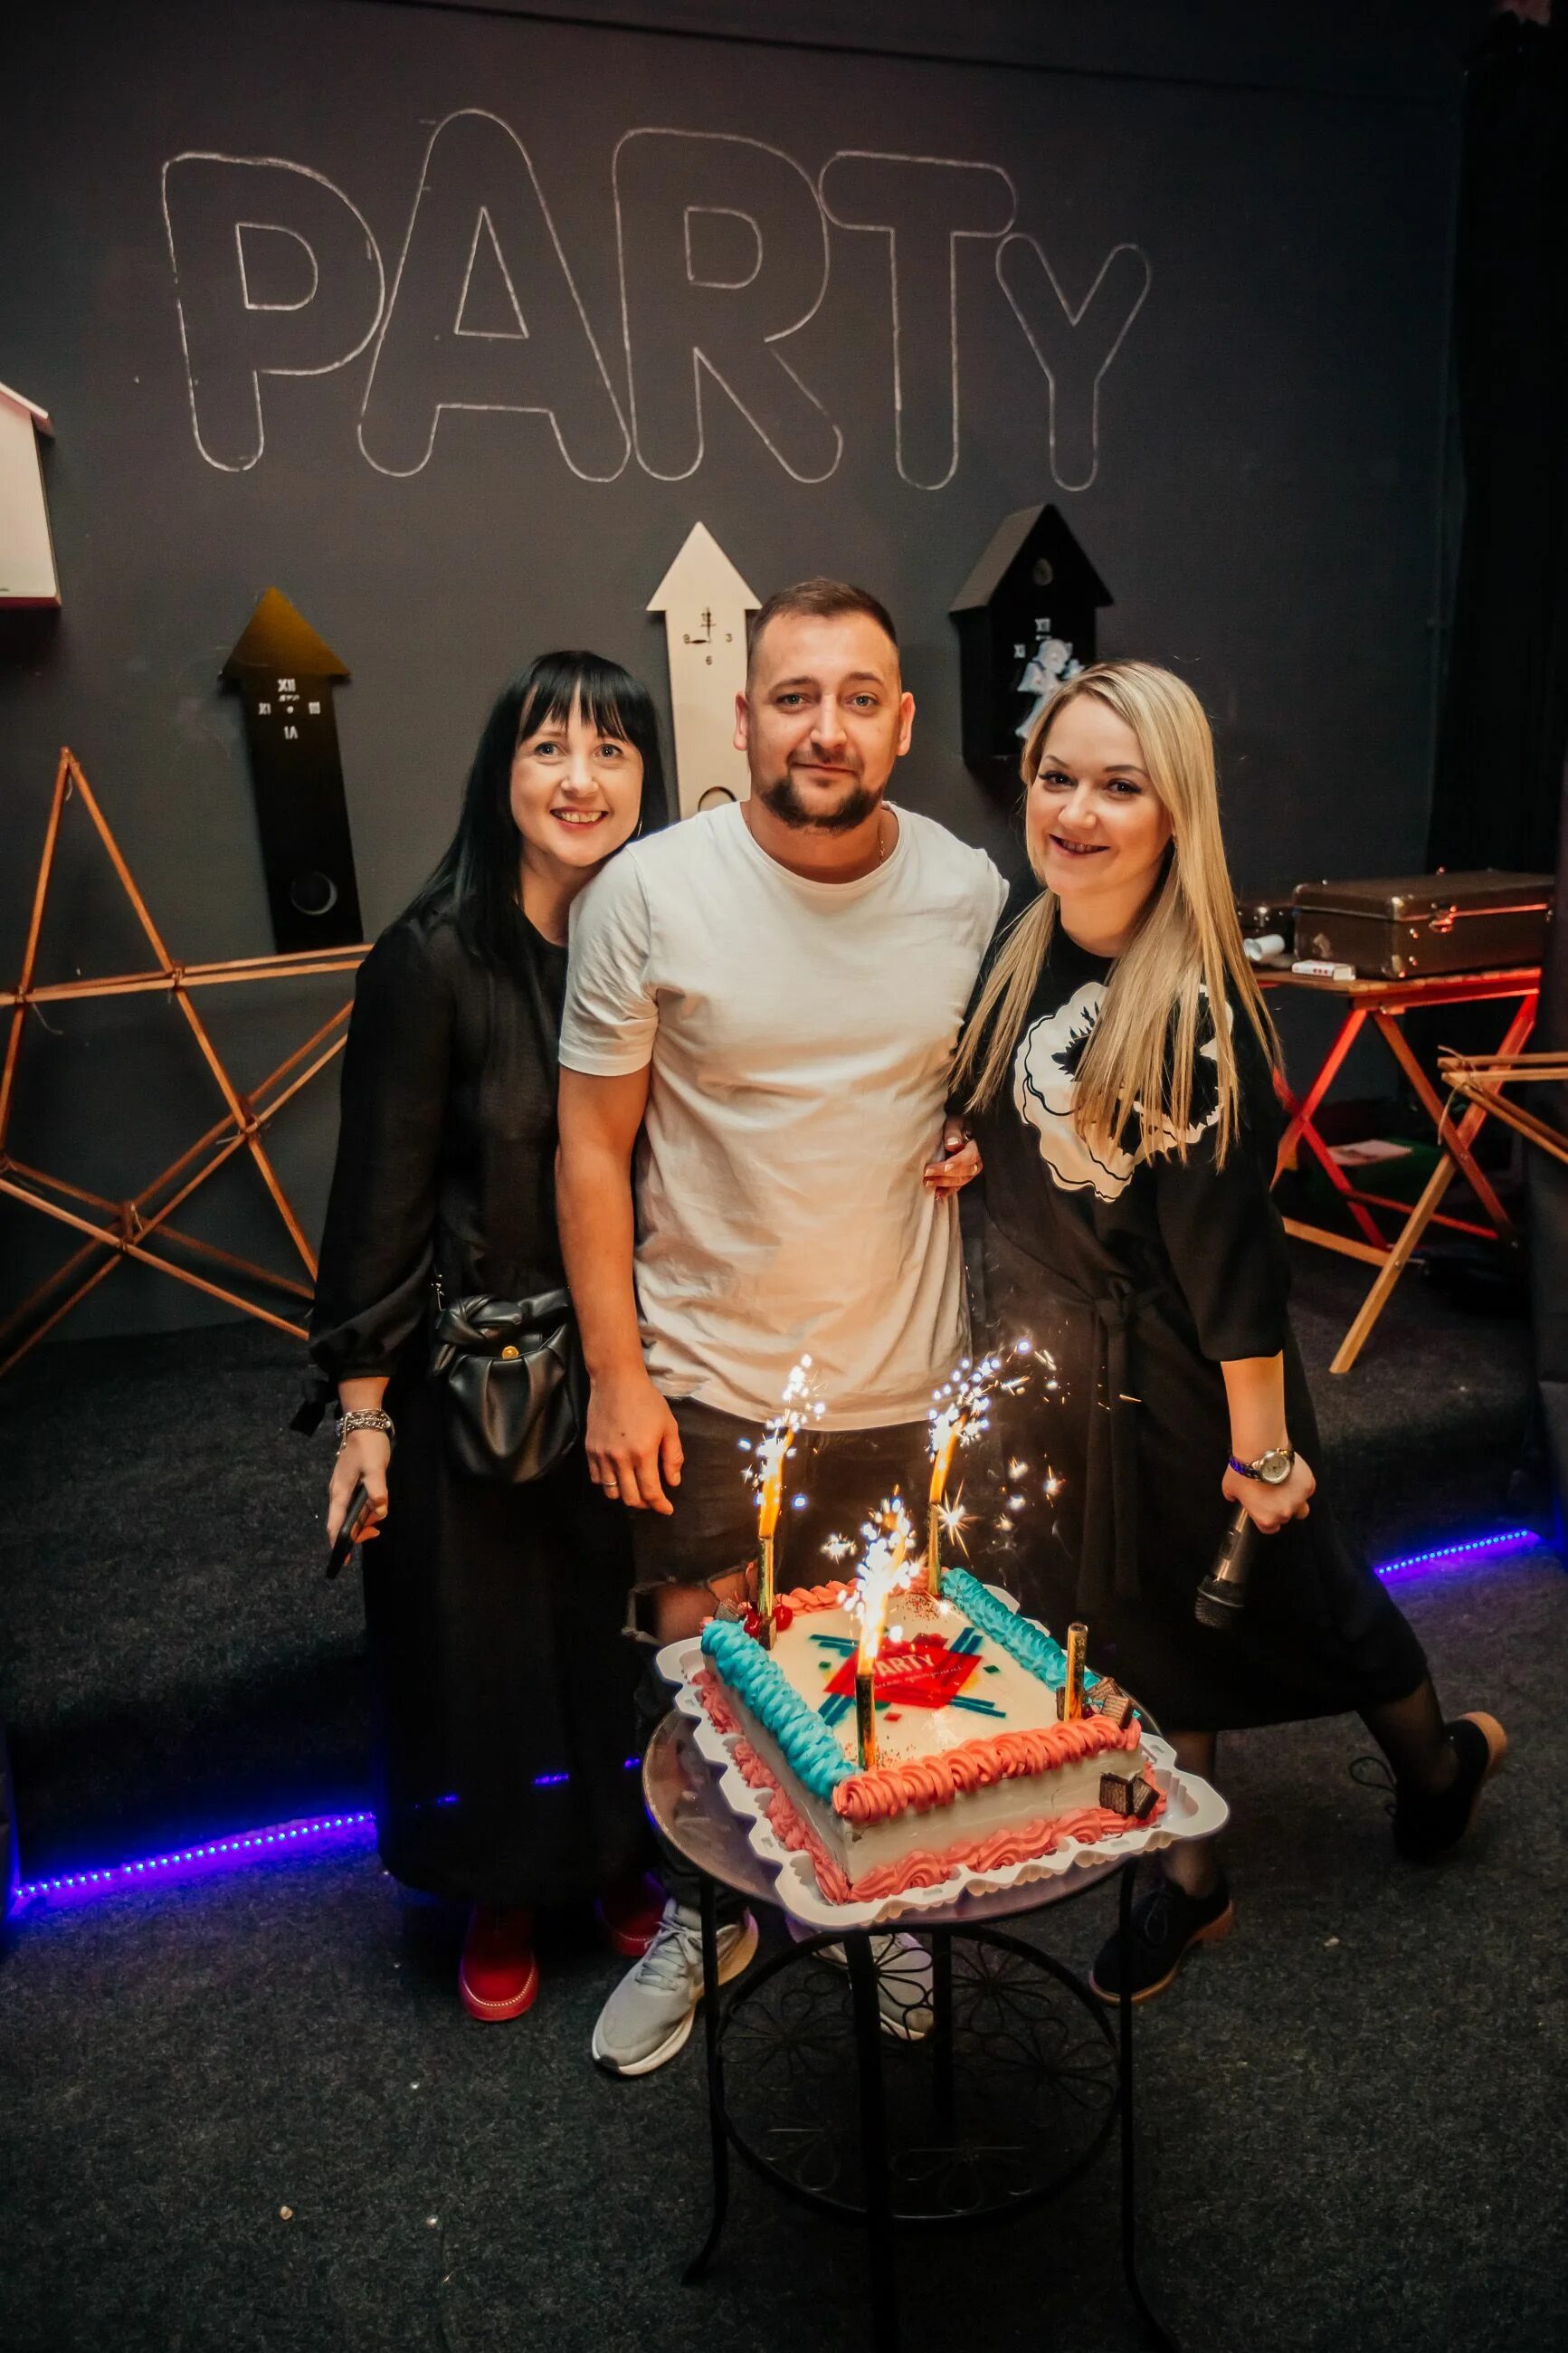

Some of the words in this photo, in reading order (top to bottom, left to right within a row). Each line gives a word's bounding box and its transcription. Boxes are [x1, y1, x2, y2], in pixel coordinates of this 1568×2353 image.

[162, 108, 1152, 491] PARTY
[726, 633, 733, 643] 3
[706, 655, 713, 665] 6
[277, 678, 296, 692] XII
[870, 1653, 935, 1678] ARTY
